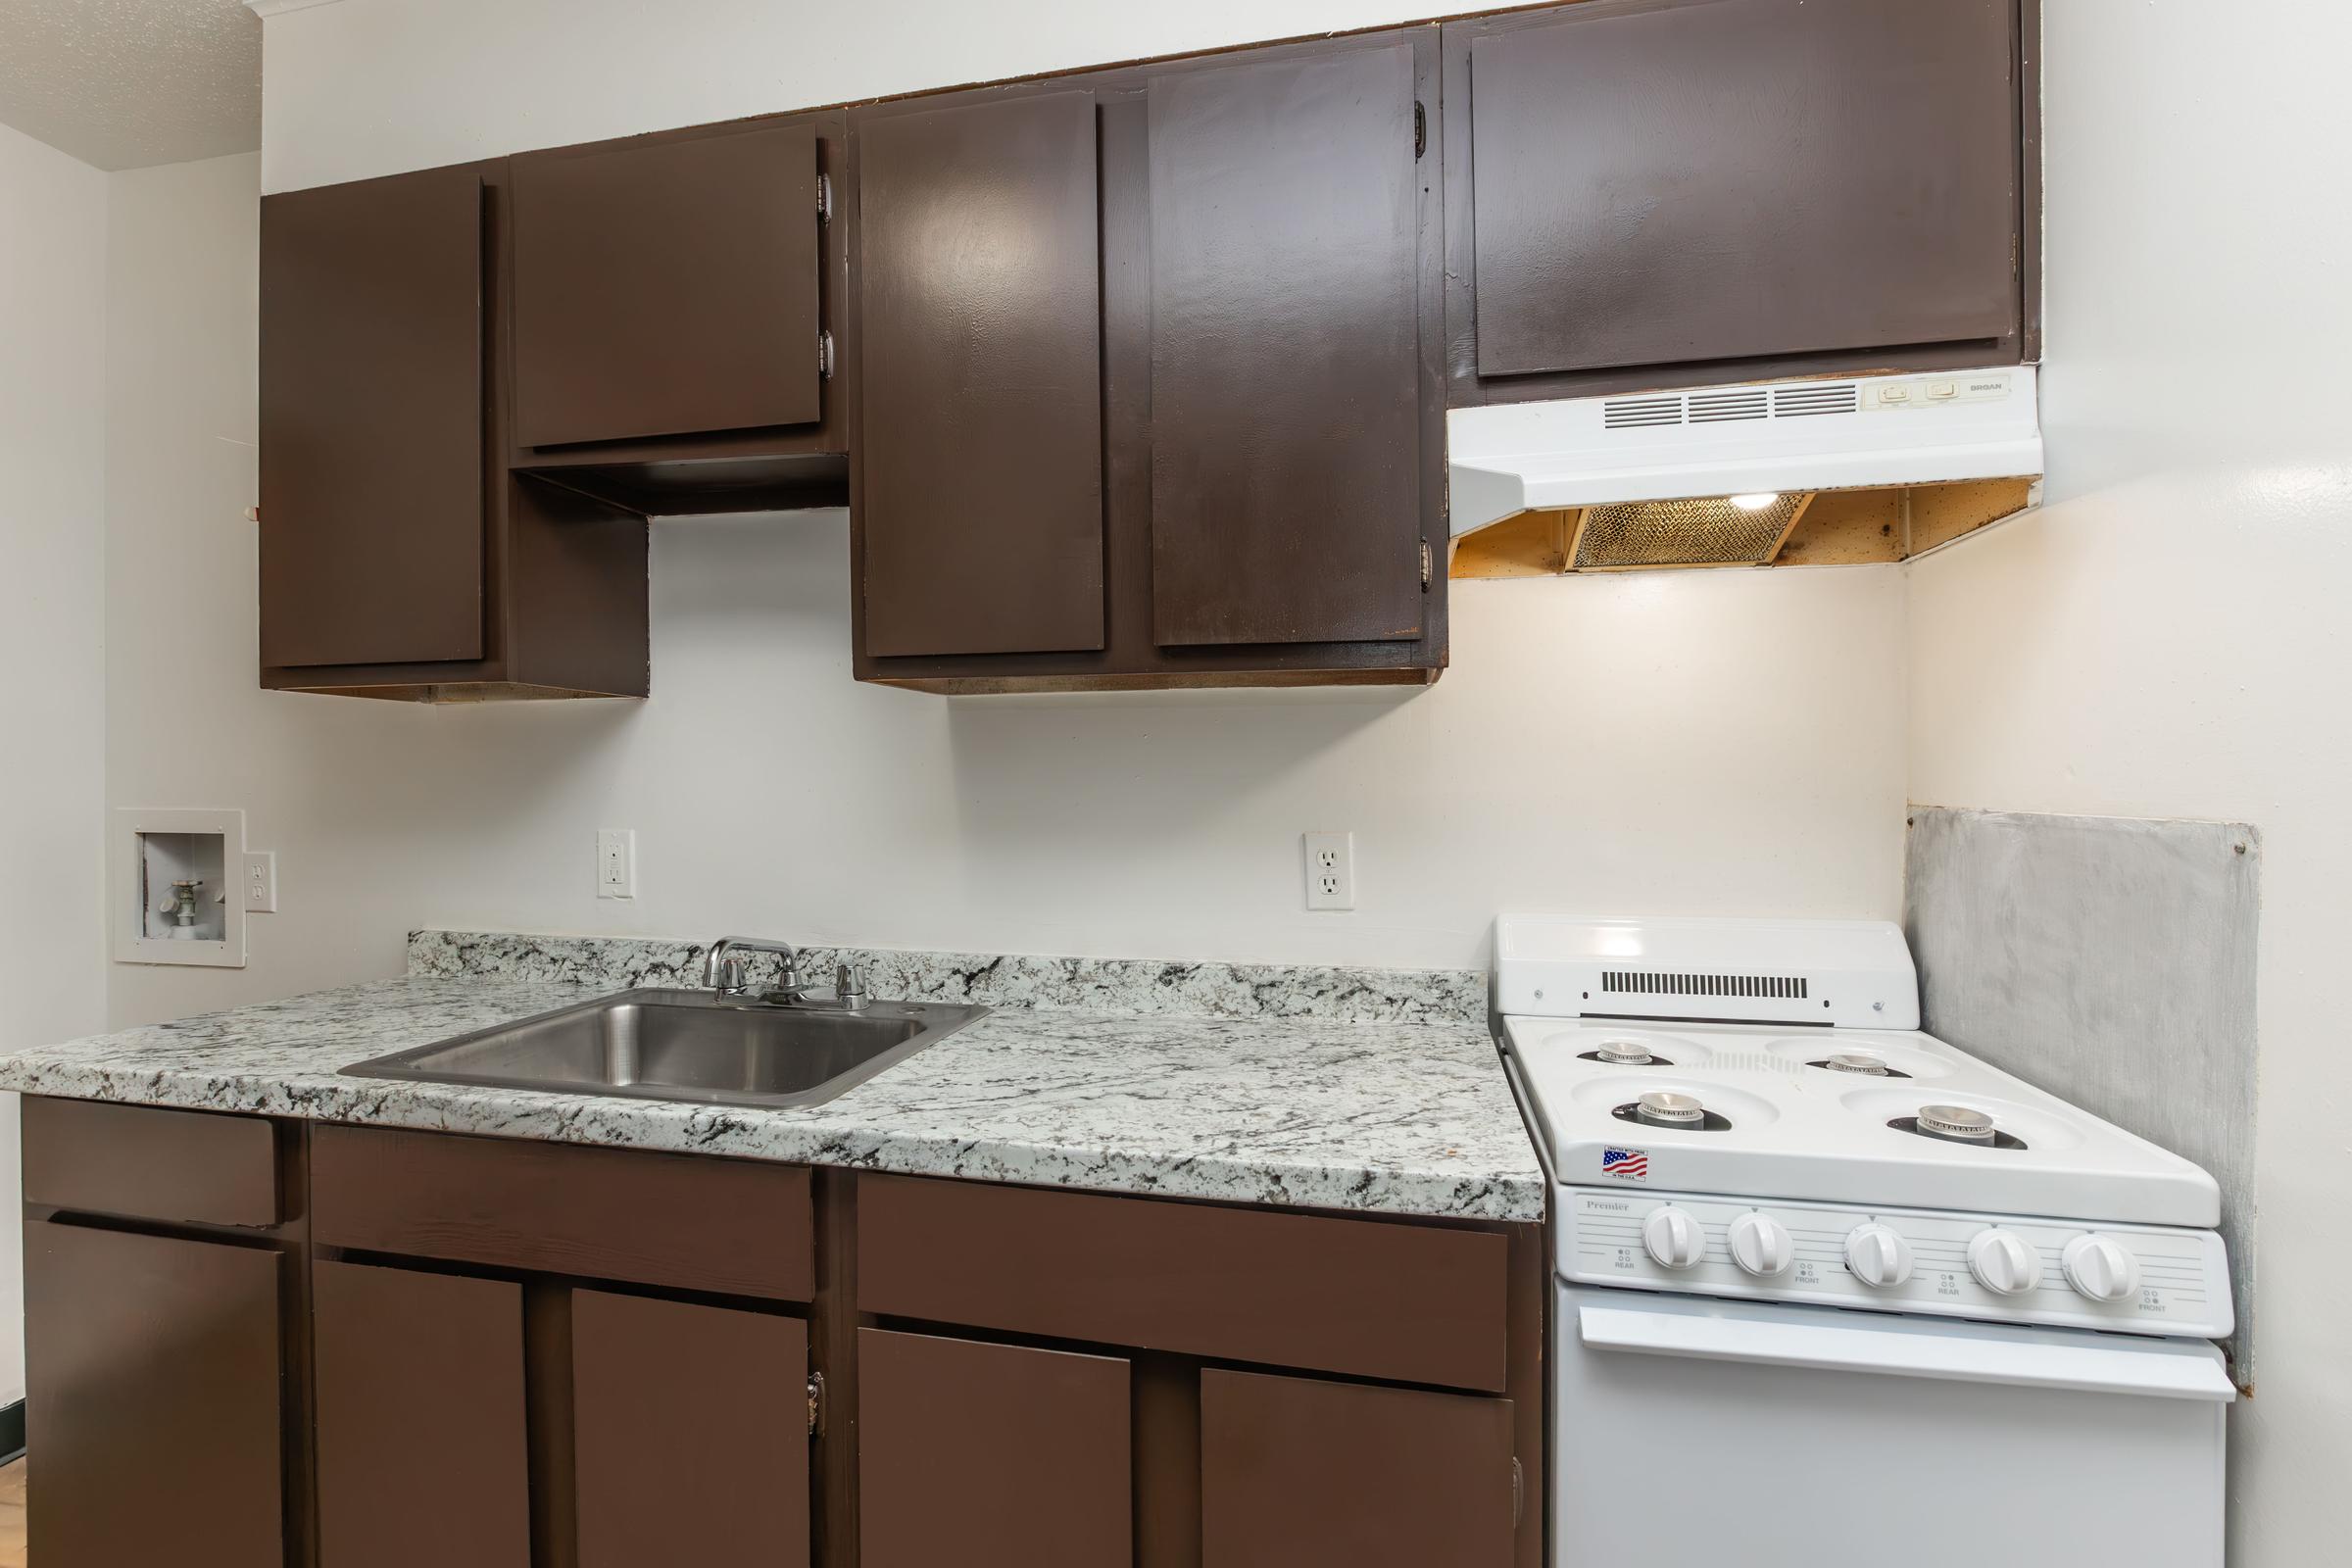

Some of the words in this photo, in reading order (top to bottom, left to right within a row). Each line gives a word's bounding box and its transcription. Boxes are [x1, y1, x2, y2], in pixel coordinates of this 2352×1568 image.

[1970, 383, 2002, 392] BROAN
[1587, 1200, 1630, 1211] Premier
[2138, 1303, 2167, 1312] FRONT
